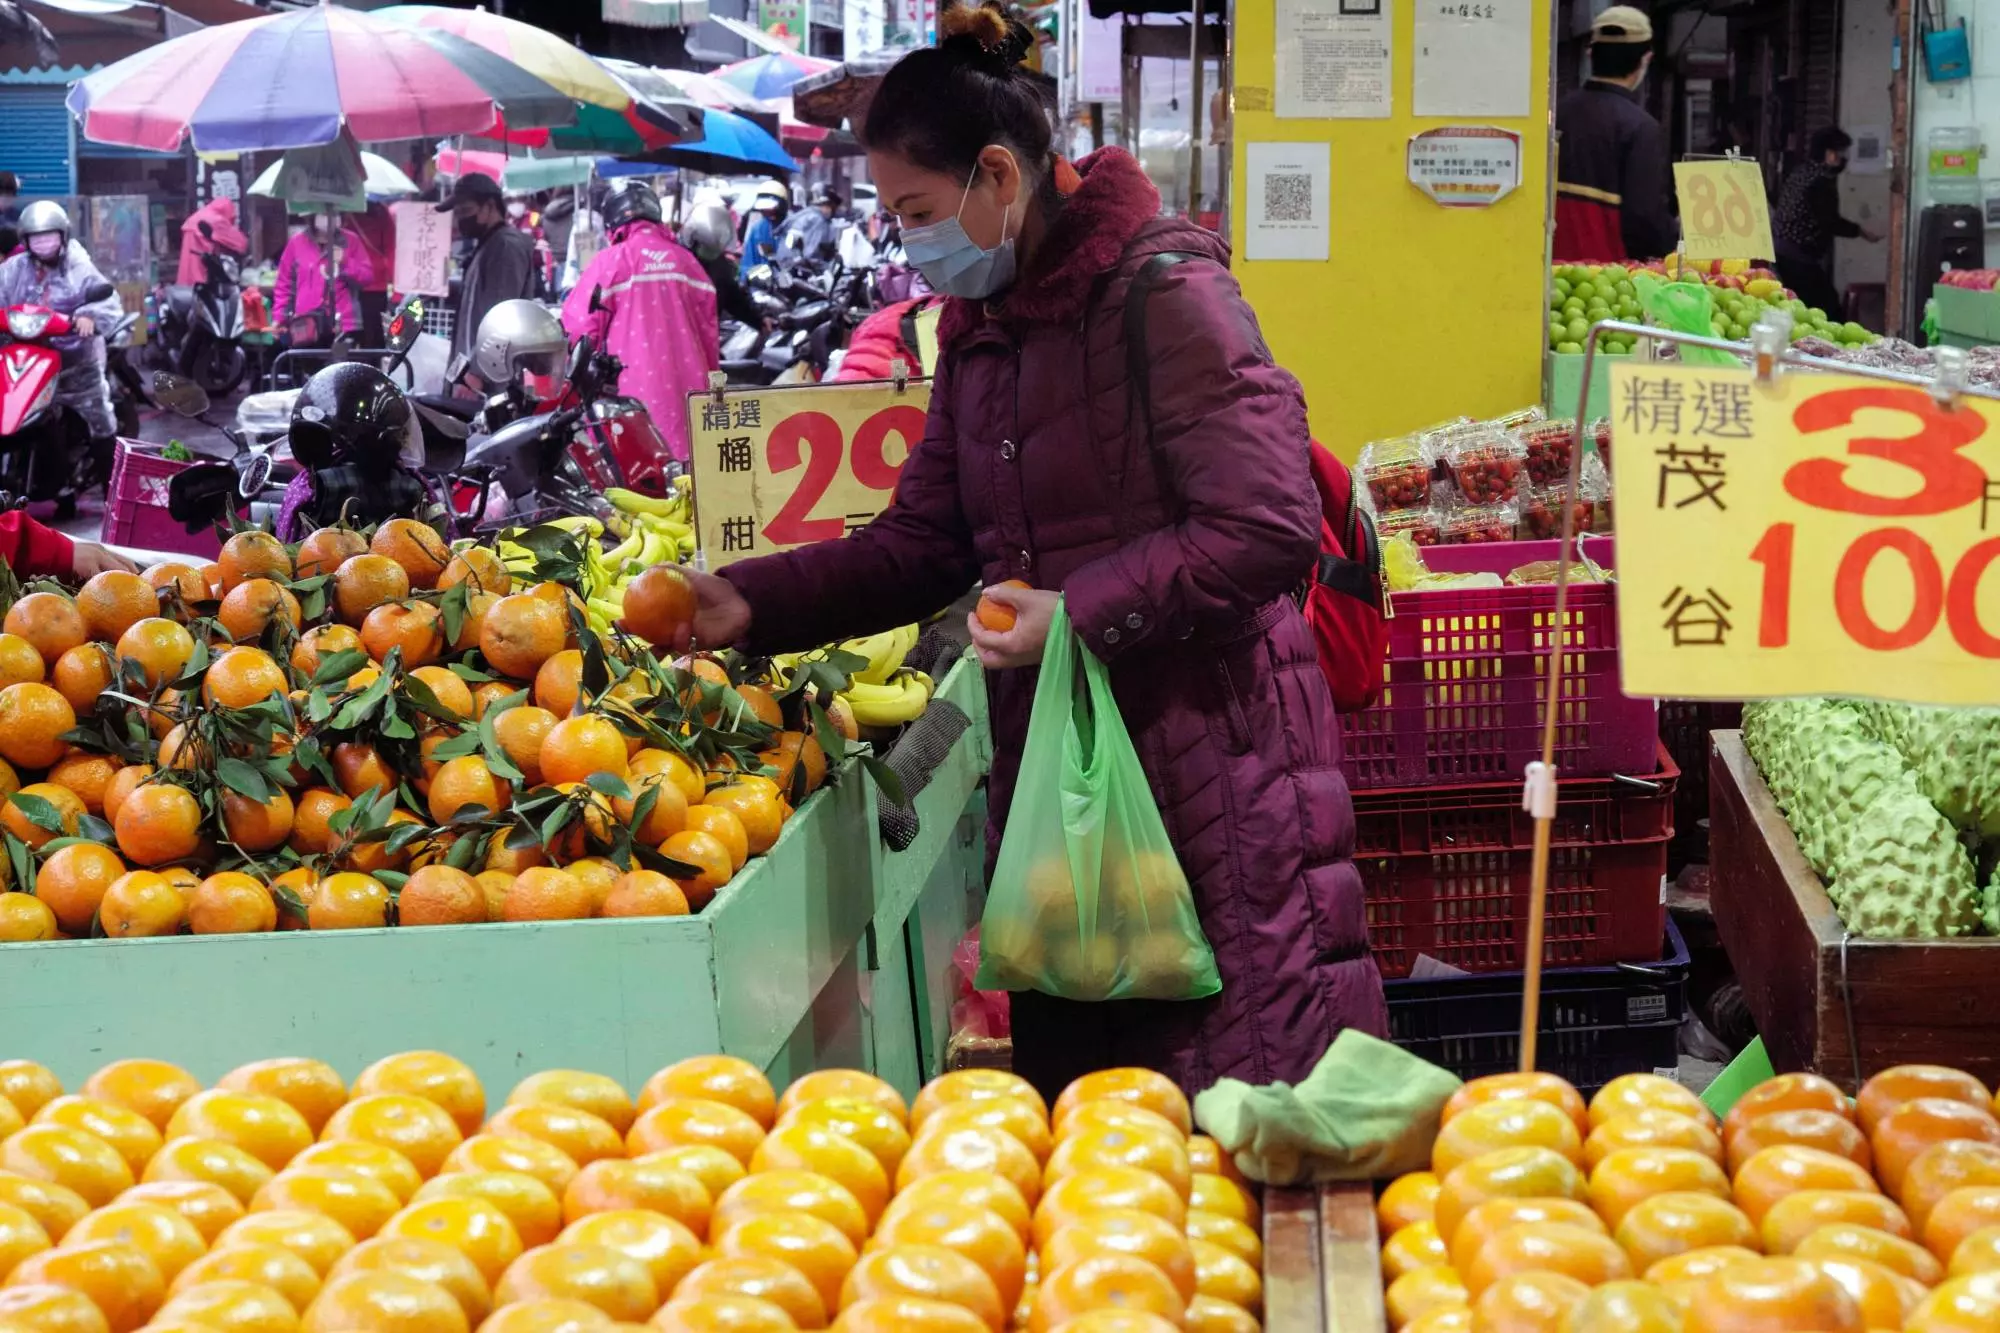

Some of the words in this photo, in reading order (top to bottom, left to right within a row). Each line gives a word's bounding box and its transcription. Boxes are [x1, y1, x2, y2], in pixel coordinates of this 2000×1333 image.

[702, 400, 761, 431] 精選
[1622, 375, 1754, 438] 精選
[1782, 386, 1988, 517] 3
[717, 436, 755, 551] 桶柑
[761, 405, 928, 545] 29
[1655, 443, 1733, 647] 茂谷
